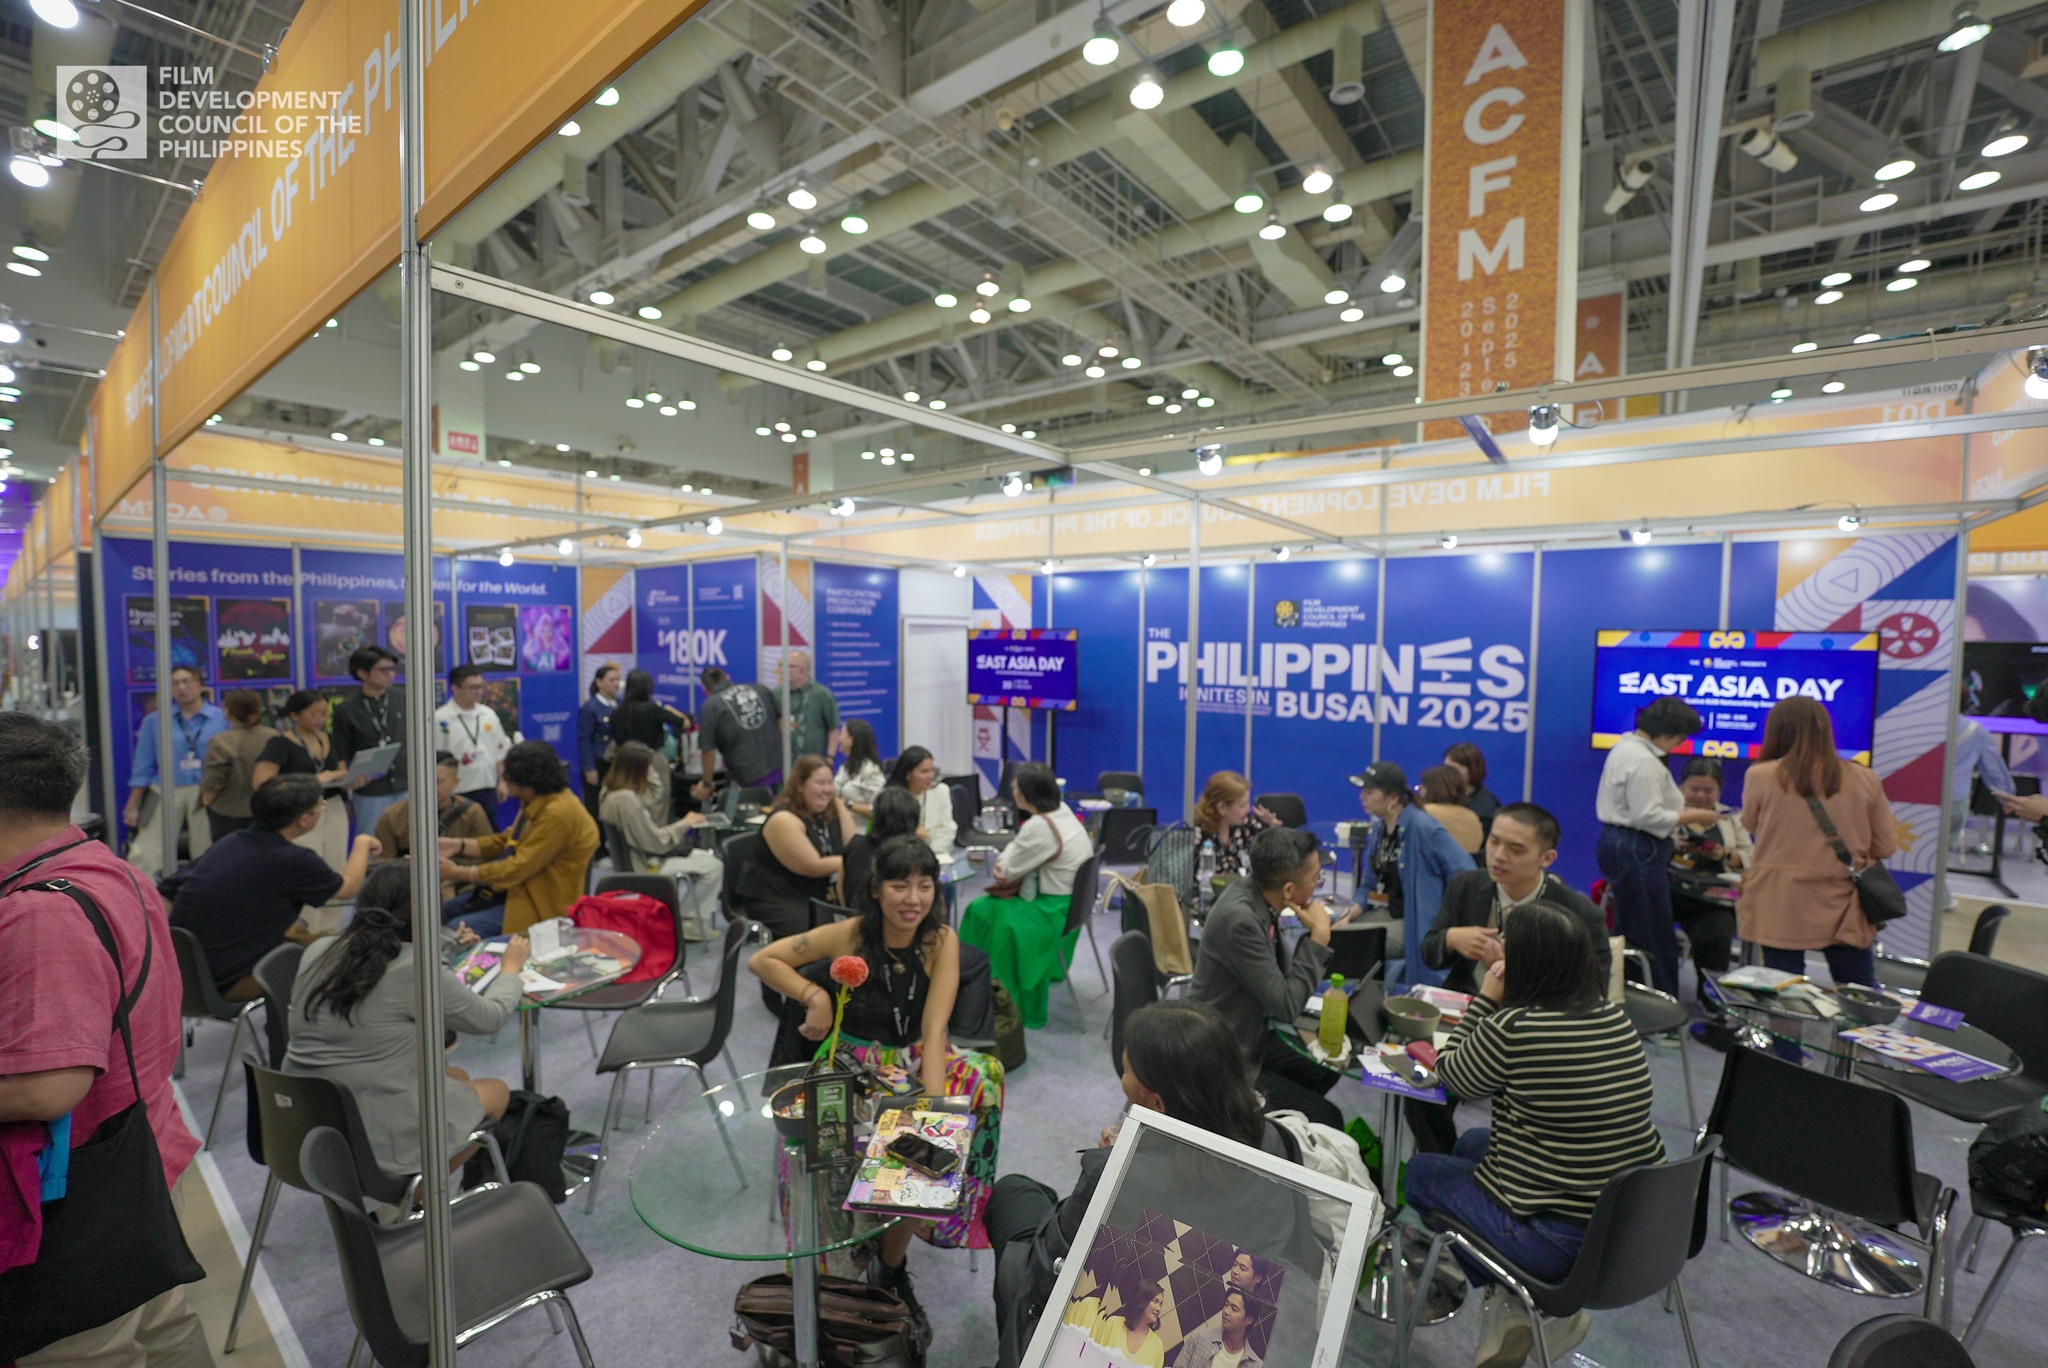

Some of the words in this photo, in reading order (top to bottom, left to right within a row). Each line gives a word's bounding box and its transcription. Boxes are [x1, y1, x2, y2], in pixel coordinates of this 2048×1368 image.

[270, 157, 299, 242] OF
[303, 81, 356, 203] THE
[1457, 23, 1529, 282] ACFM
[1504, 292, 1519, 369] 2025
[132, 565, 208, 584] Stries
[211, 568, 259, 585] from
[263, 571, 295, 586] the
[300, 572, 398, 590] Philippines,
[479, 579, 502, 594] the
[504, 582, 548, 596] World.
[657, 629, 728, 666] $180K
[1148, 628, 1171, 639] THE
[976, 654, 1008, 670] EAST
[1007, 655, 1037, 671] ASIA
[1038, 656, 1065, 672] DAY
[1146, 636, 1525, 699] PHILIPPINES
[1179, 686, 1246, 704] INITES
[1619, 671, 1693, 696] EAST
[1696, 674, 1770, 699] ASIA
[1776, 677, 1844, 701] DAY
[1276, 691, 1409, 725] BUSAN
[1417, 697, 1529, 733] 2025
